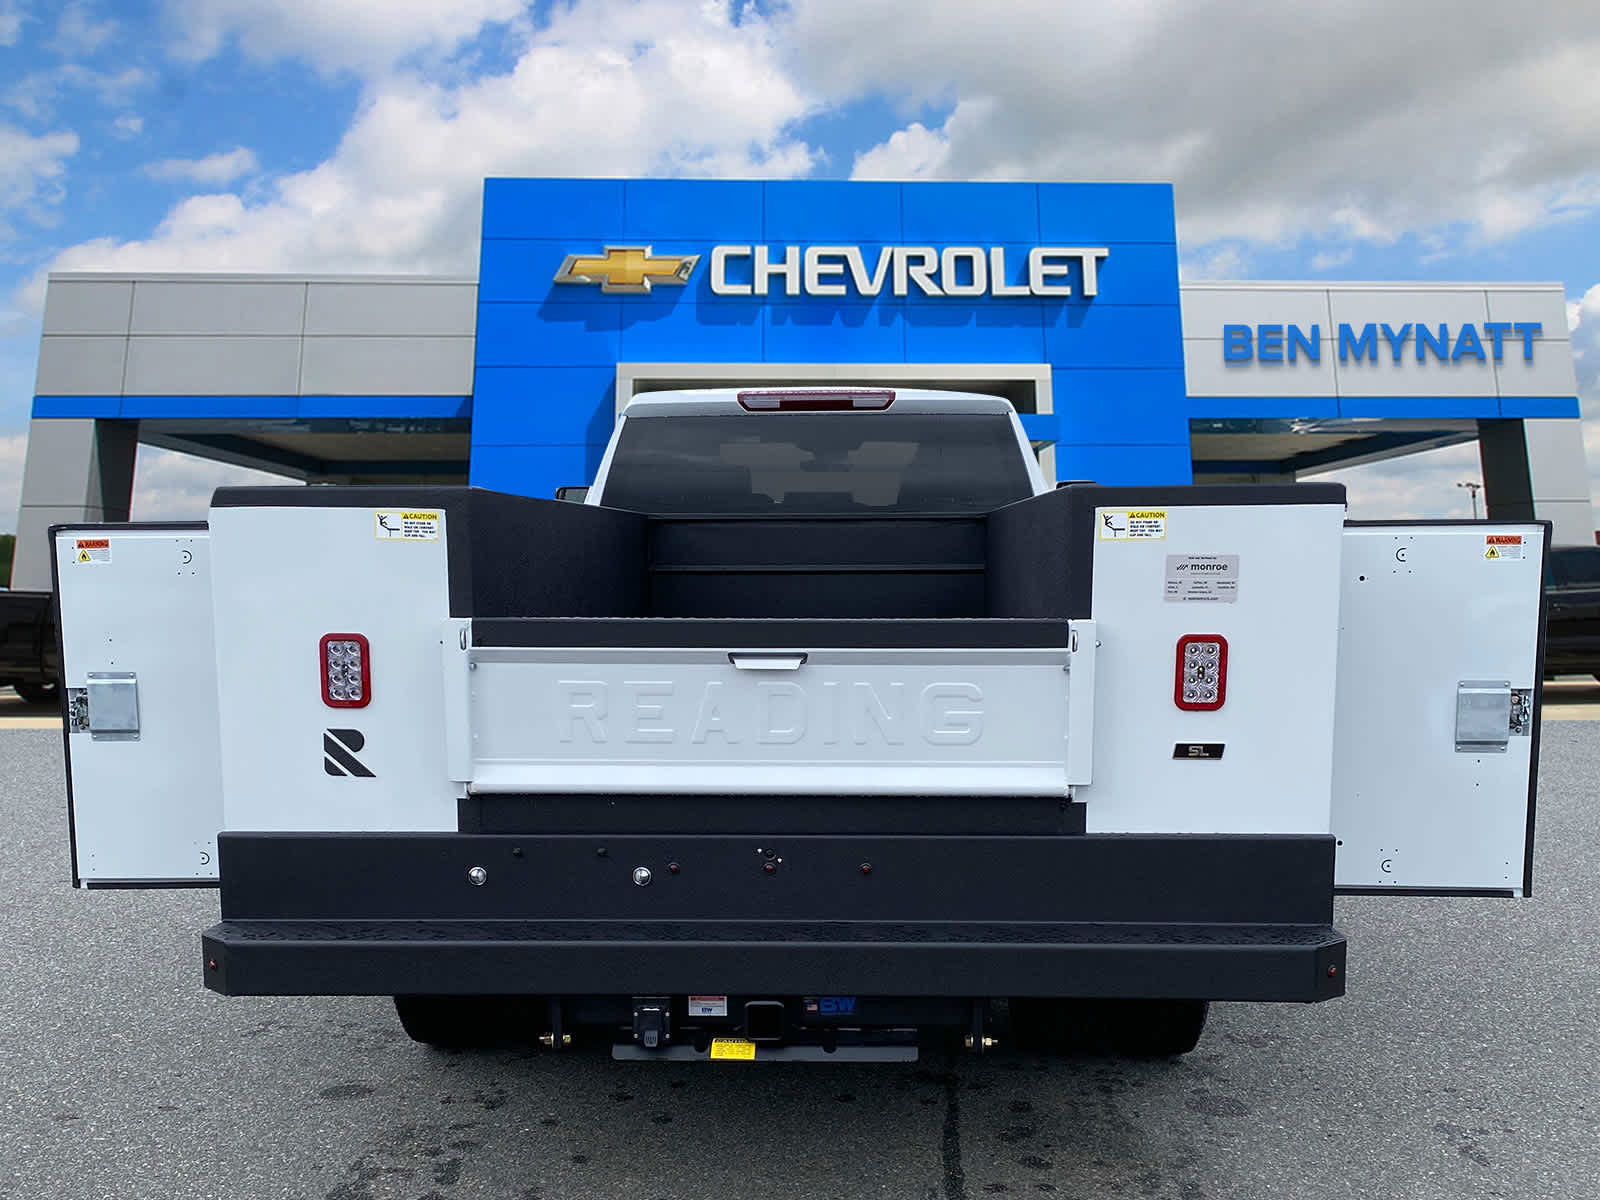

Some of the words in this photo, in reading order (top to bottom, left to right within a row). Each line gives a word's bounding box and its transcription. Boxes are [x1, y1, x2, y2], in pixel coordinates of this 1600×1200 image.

[710, 245, 1109, 298] CHEVROLET
[1223, 323, 1321, 366] BEN
[1338, 322, 1542, 366] MYNATT
[409, 512, 438, 520] CAUTION
[1135, 511, 1165, 519] CAUTION
[1190, 563, 1228, 571] monroe
[556, 679, 986, 747] READING
[1188, 745, 1210, 757] SL
